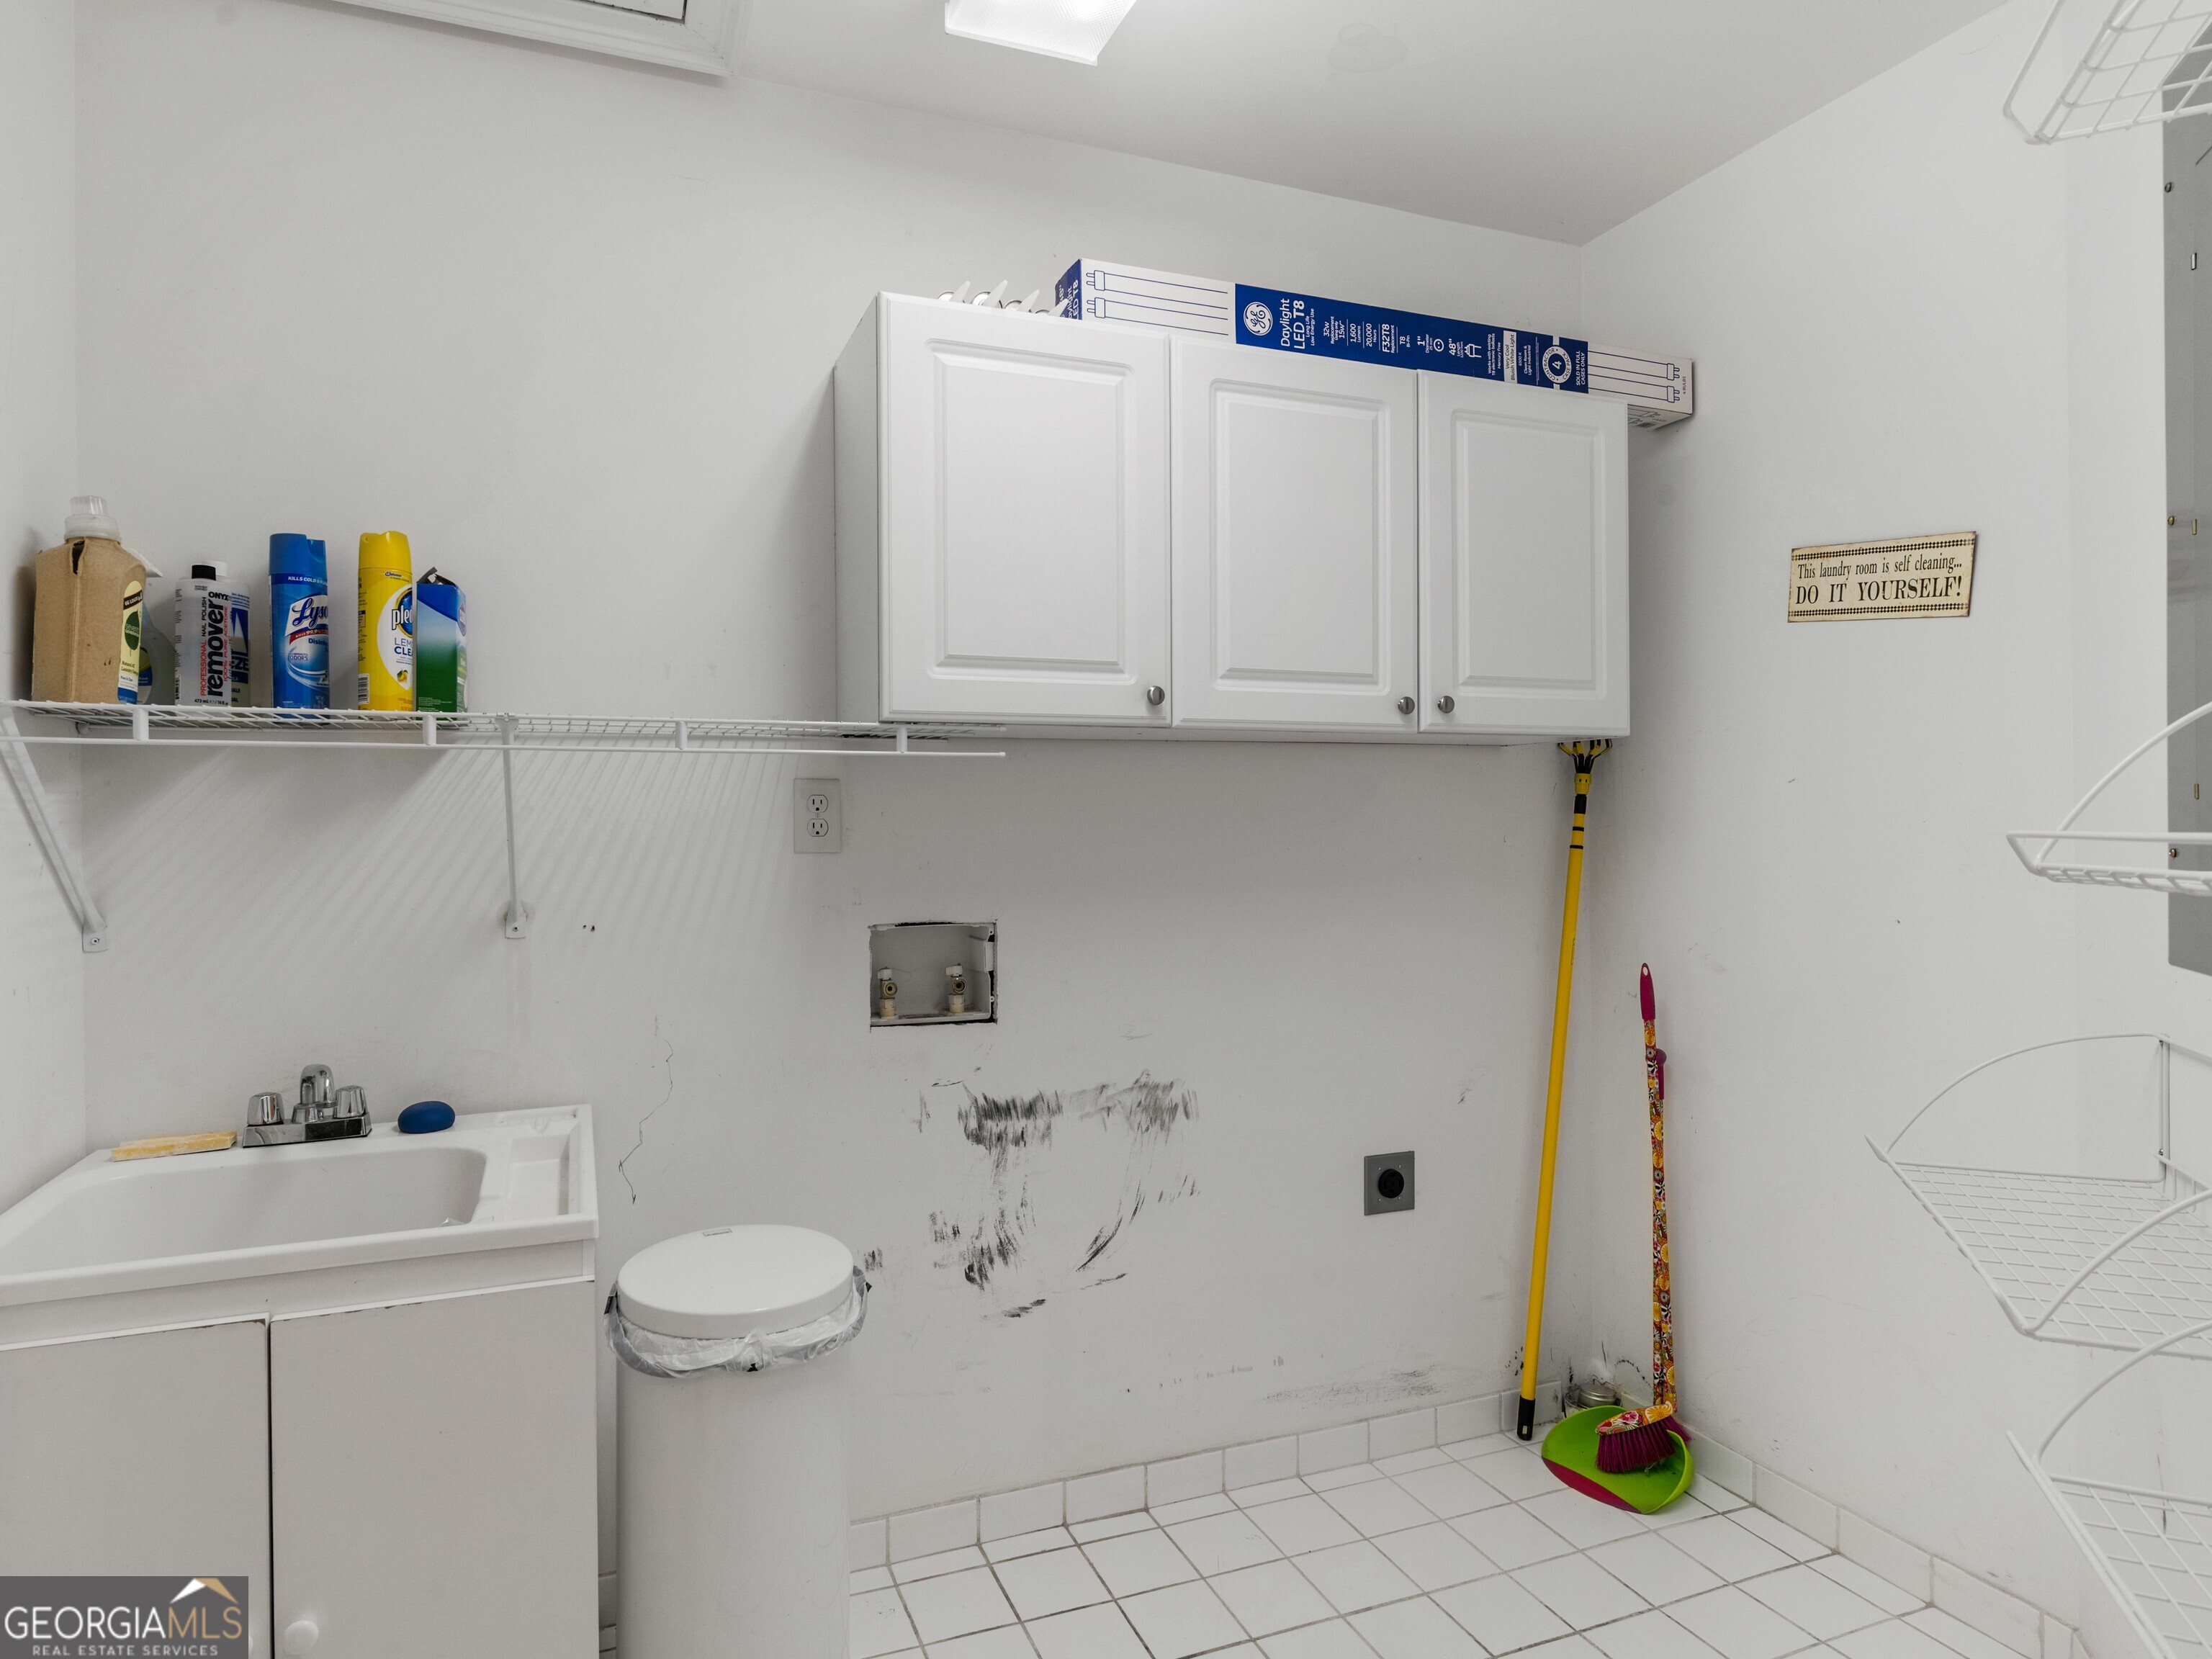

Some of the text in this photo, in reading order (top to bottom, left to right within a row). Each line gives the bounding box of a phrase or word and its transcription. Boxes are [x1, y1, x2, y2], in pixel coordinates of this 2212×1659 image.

[1073, 279, 1079, 298] T8
[1280, 298, 1292, 346] Daylight
[1293, 300, 1305, 349] LED T8
[1399, 336, 1406, 345] T8
[1429, 337, 1433, 346] mm
[1544, 348, 1555, 380] CONTRACTOR
[1552, 361, 1562, 369] 4
[1563, 367, 1571, 379] CASE
[1798, 553, 1962, 580] This laundry room is self cleaning...
[208, 591, 229, 601] ONYX
[1796, 575, 1962, 605] DO IT YOURSELF!
[207, 598, 223, 696] remover
